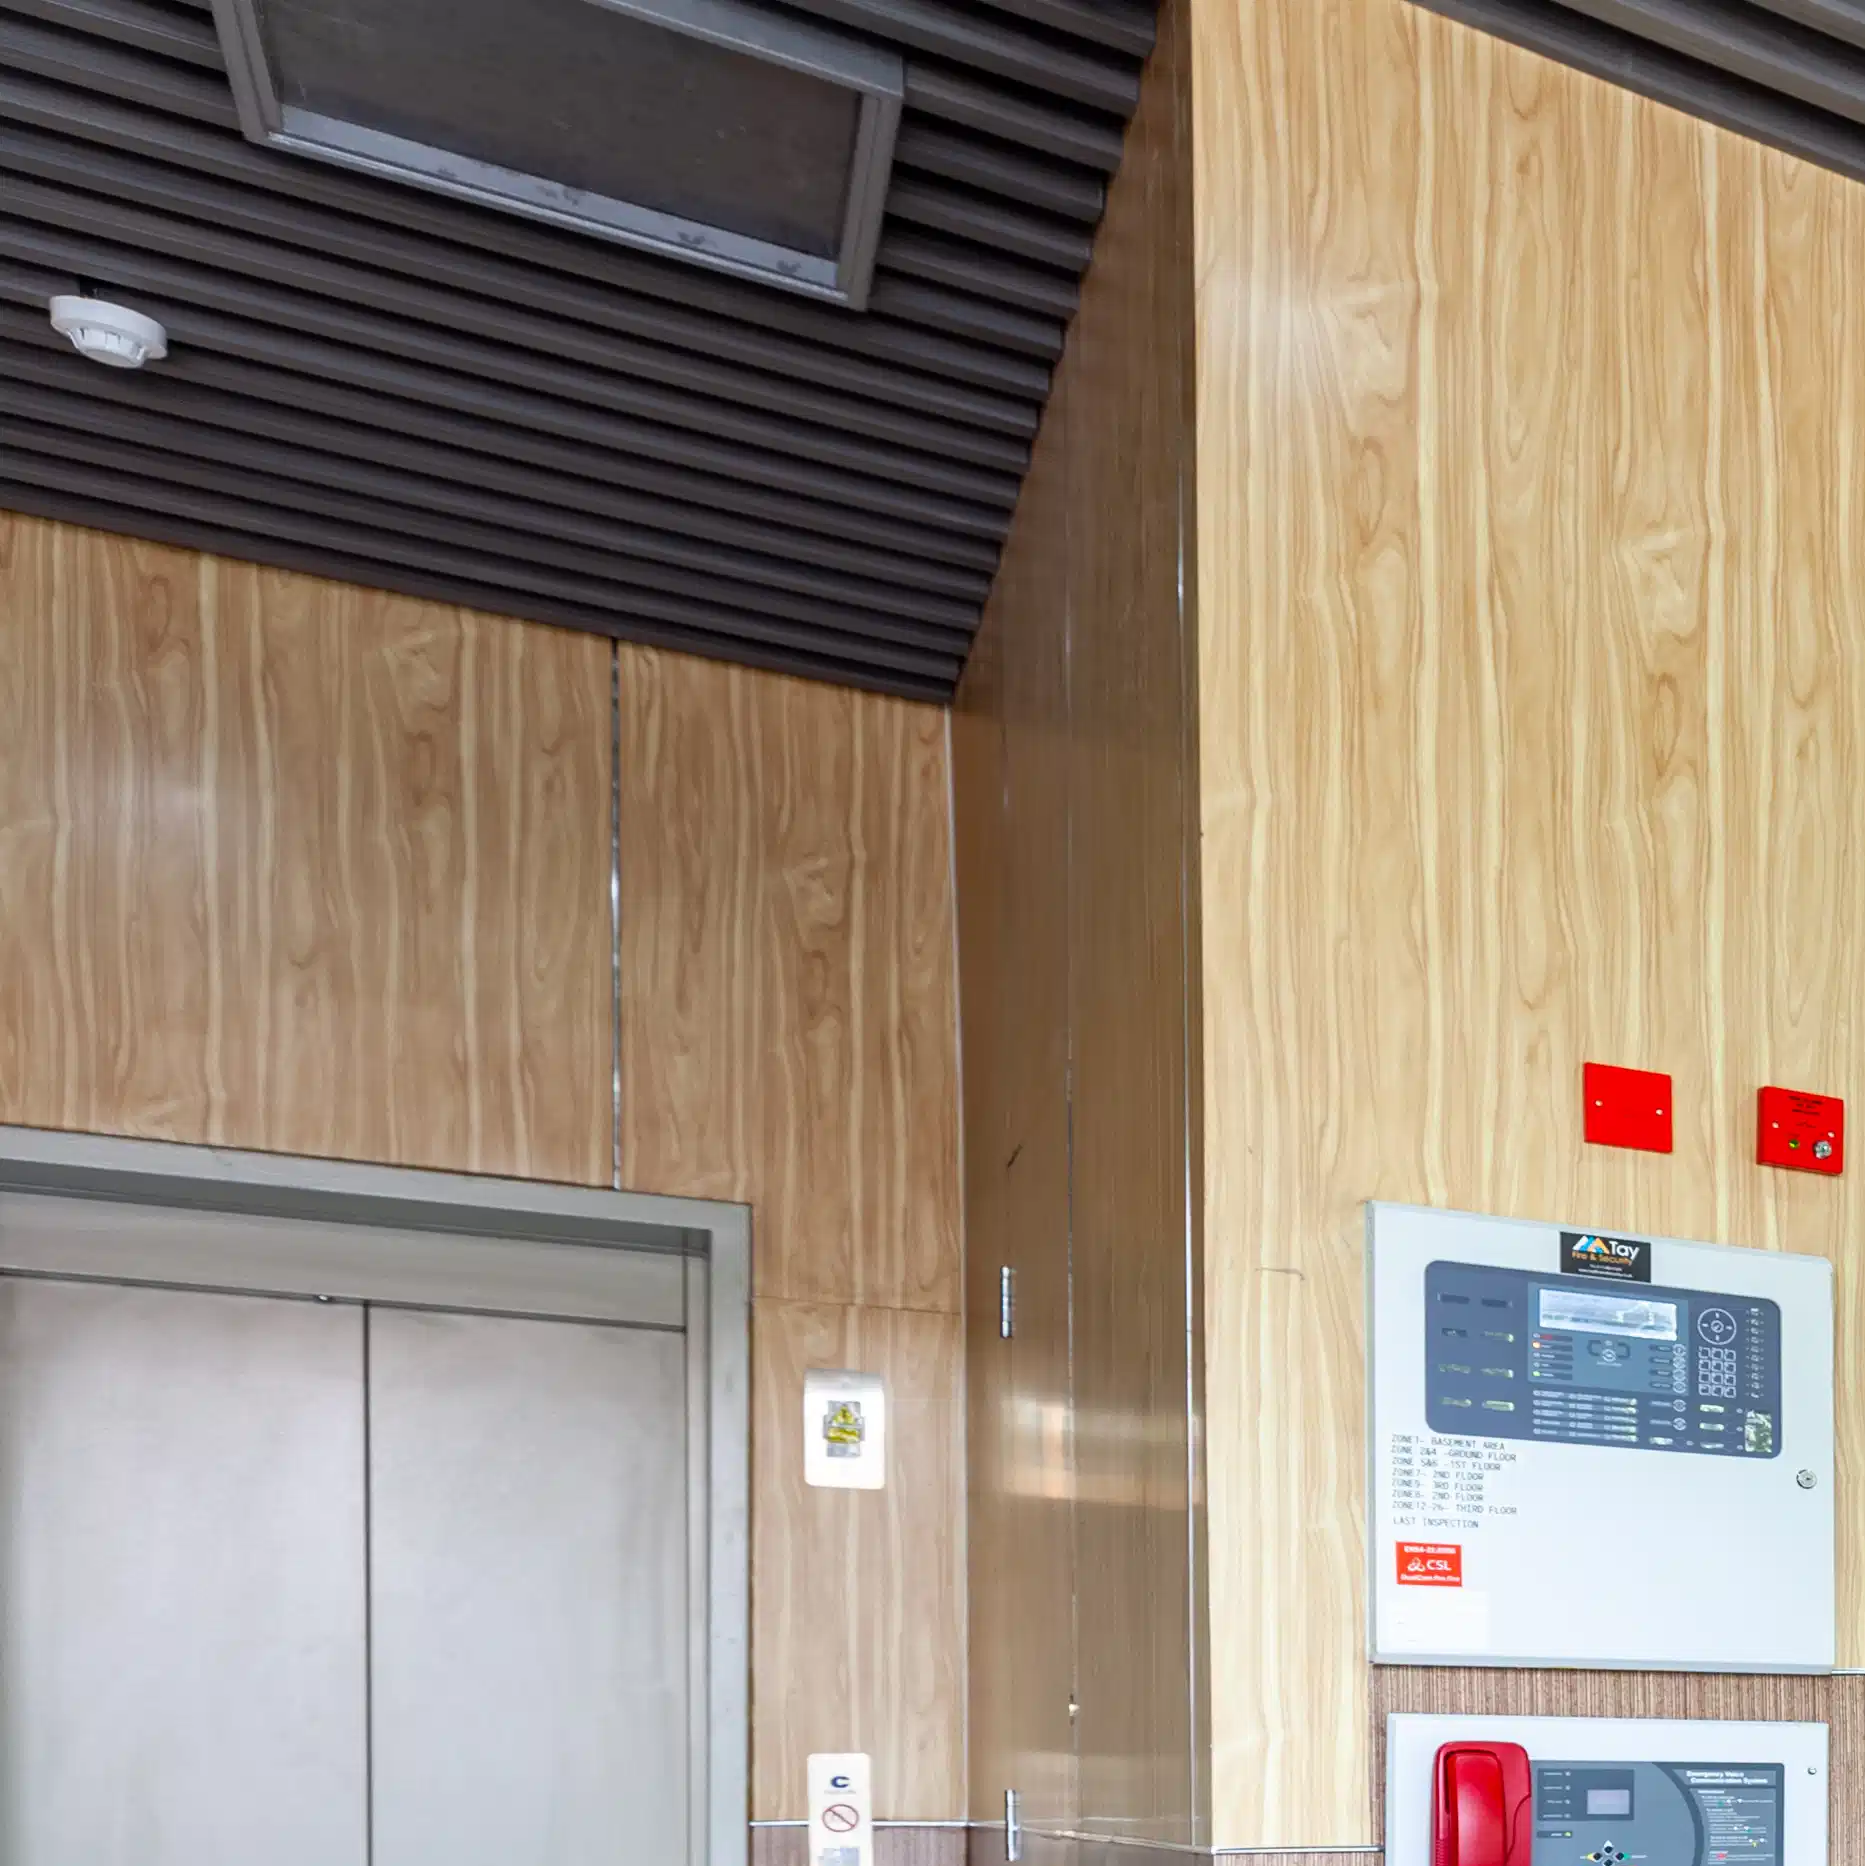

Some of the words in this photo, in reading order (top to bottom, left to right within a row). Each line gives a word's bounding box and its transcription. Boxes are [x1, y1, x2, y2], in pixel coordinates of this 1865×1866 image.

[1609, 1240, 1640, 1260] Tay
[1431, 1436, 1476, 1448] BASEMENT
[1483, 1441, 1505, 1451] AREA
[1392, 1445, 1412, 1455] ZONE
[1488, 1452, 1517, 1462] FLOOR
[1392, 1457, 1413, 1466] ZONE
[1472, 1461, 1501, 1471] FLOOR
[1455, 1471, 1484, 1481] FLOOR
[1454, 1482, 1484, 1491] FLOOR
[1455, 1492, 1484, 1502] FLOOR
[1456, 1503, 1484, 1513] THIRD
[1488, 1505, 1518, 1515] FLOOR
[1393, 1516, 1416, 1525] LAST
[1423, 1517, 1479, 1529] INSPECTION
[1426, 1558, 1453, 1570] CSL
[1686, 1770, 1724, 1779] Emergency
